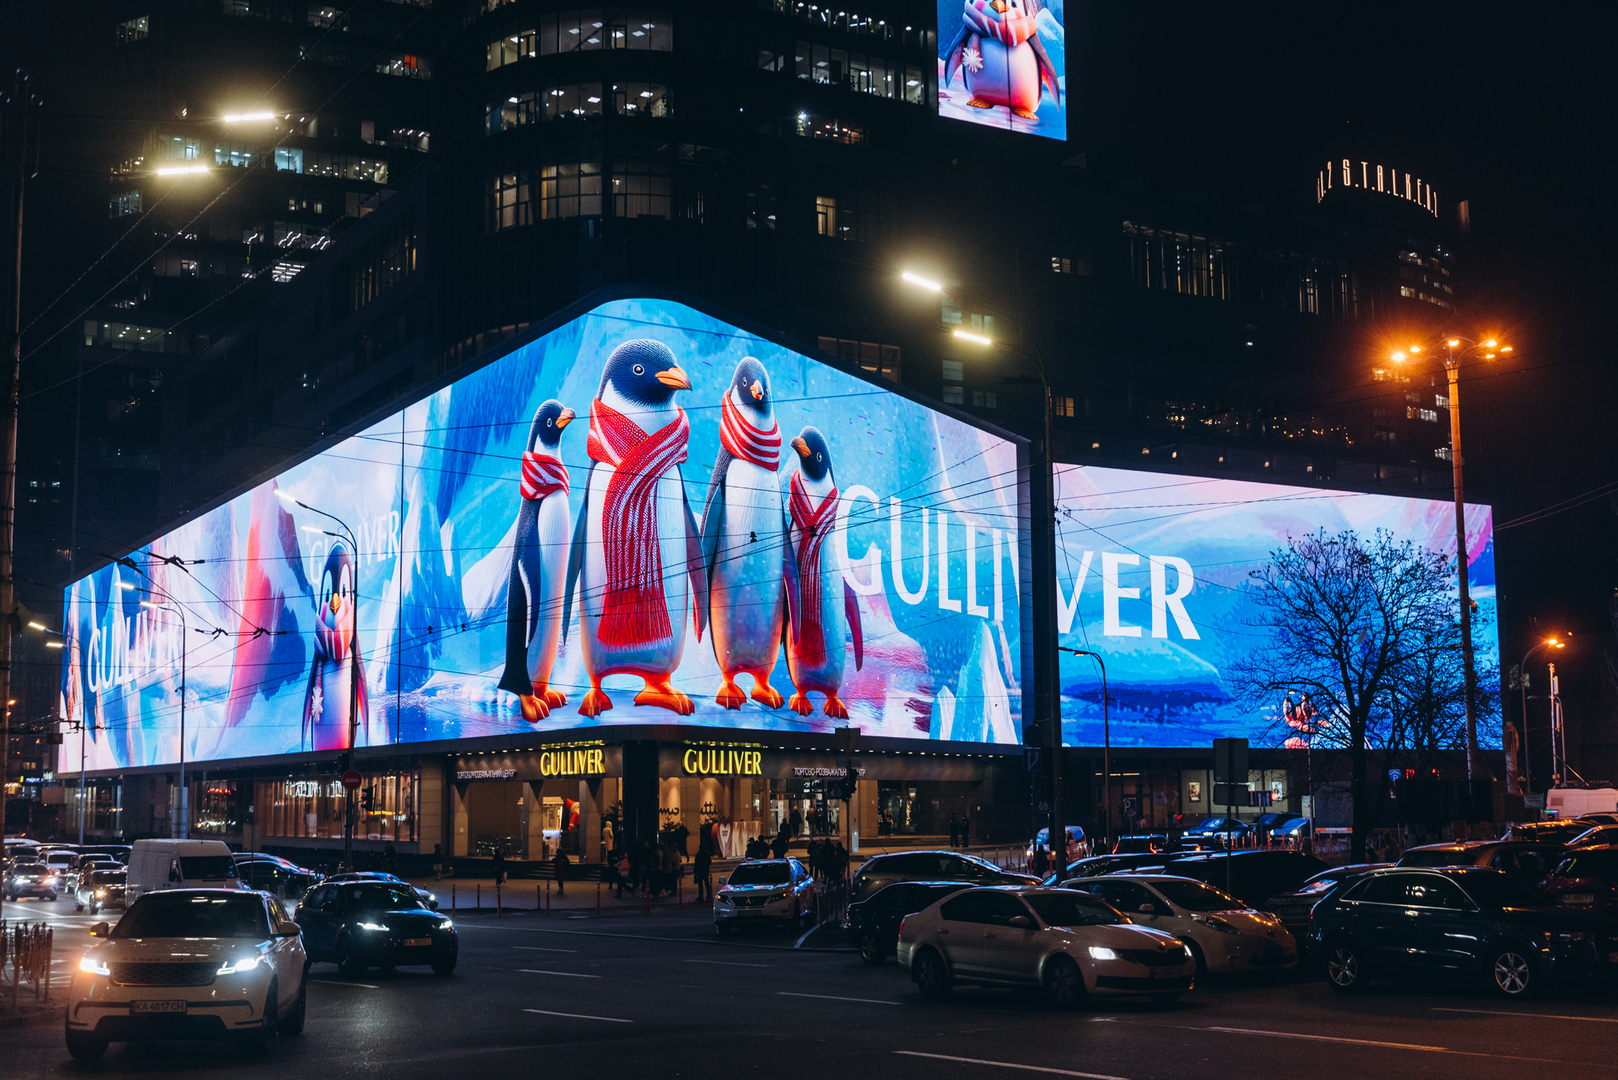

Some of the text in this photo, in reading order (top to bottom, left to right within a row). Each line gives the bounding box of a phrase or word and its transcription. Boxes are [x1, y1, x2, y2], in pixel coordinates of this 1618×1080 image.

[309, 510, 401, 585] GLIVER
[540, 749, 605, 776] GULLIVER
[683, 749, 762, 776] GULLIVER
[794, 768, 847, 777] ТОРГОВО-РОЗВАЖАЛЬН
[136, 1002, 184, 1011] KA 4817 CH
